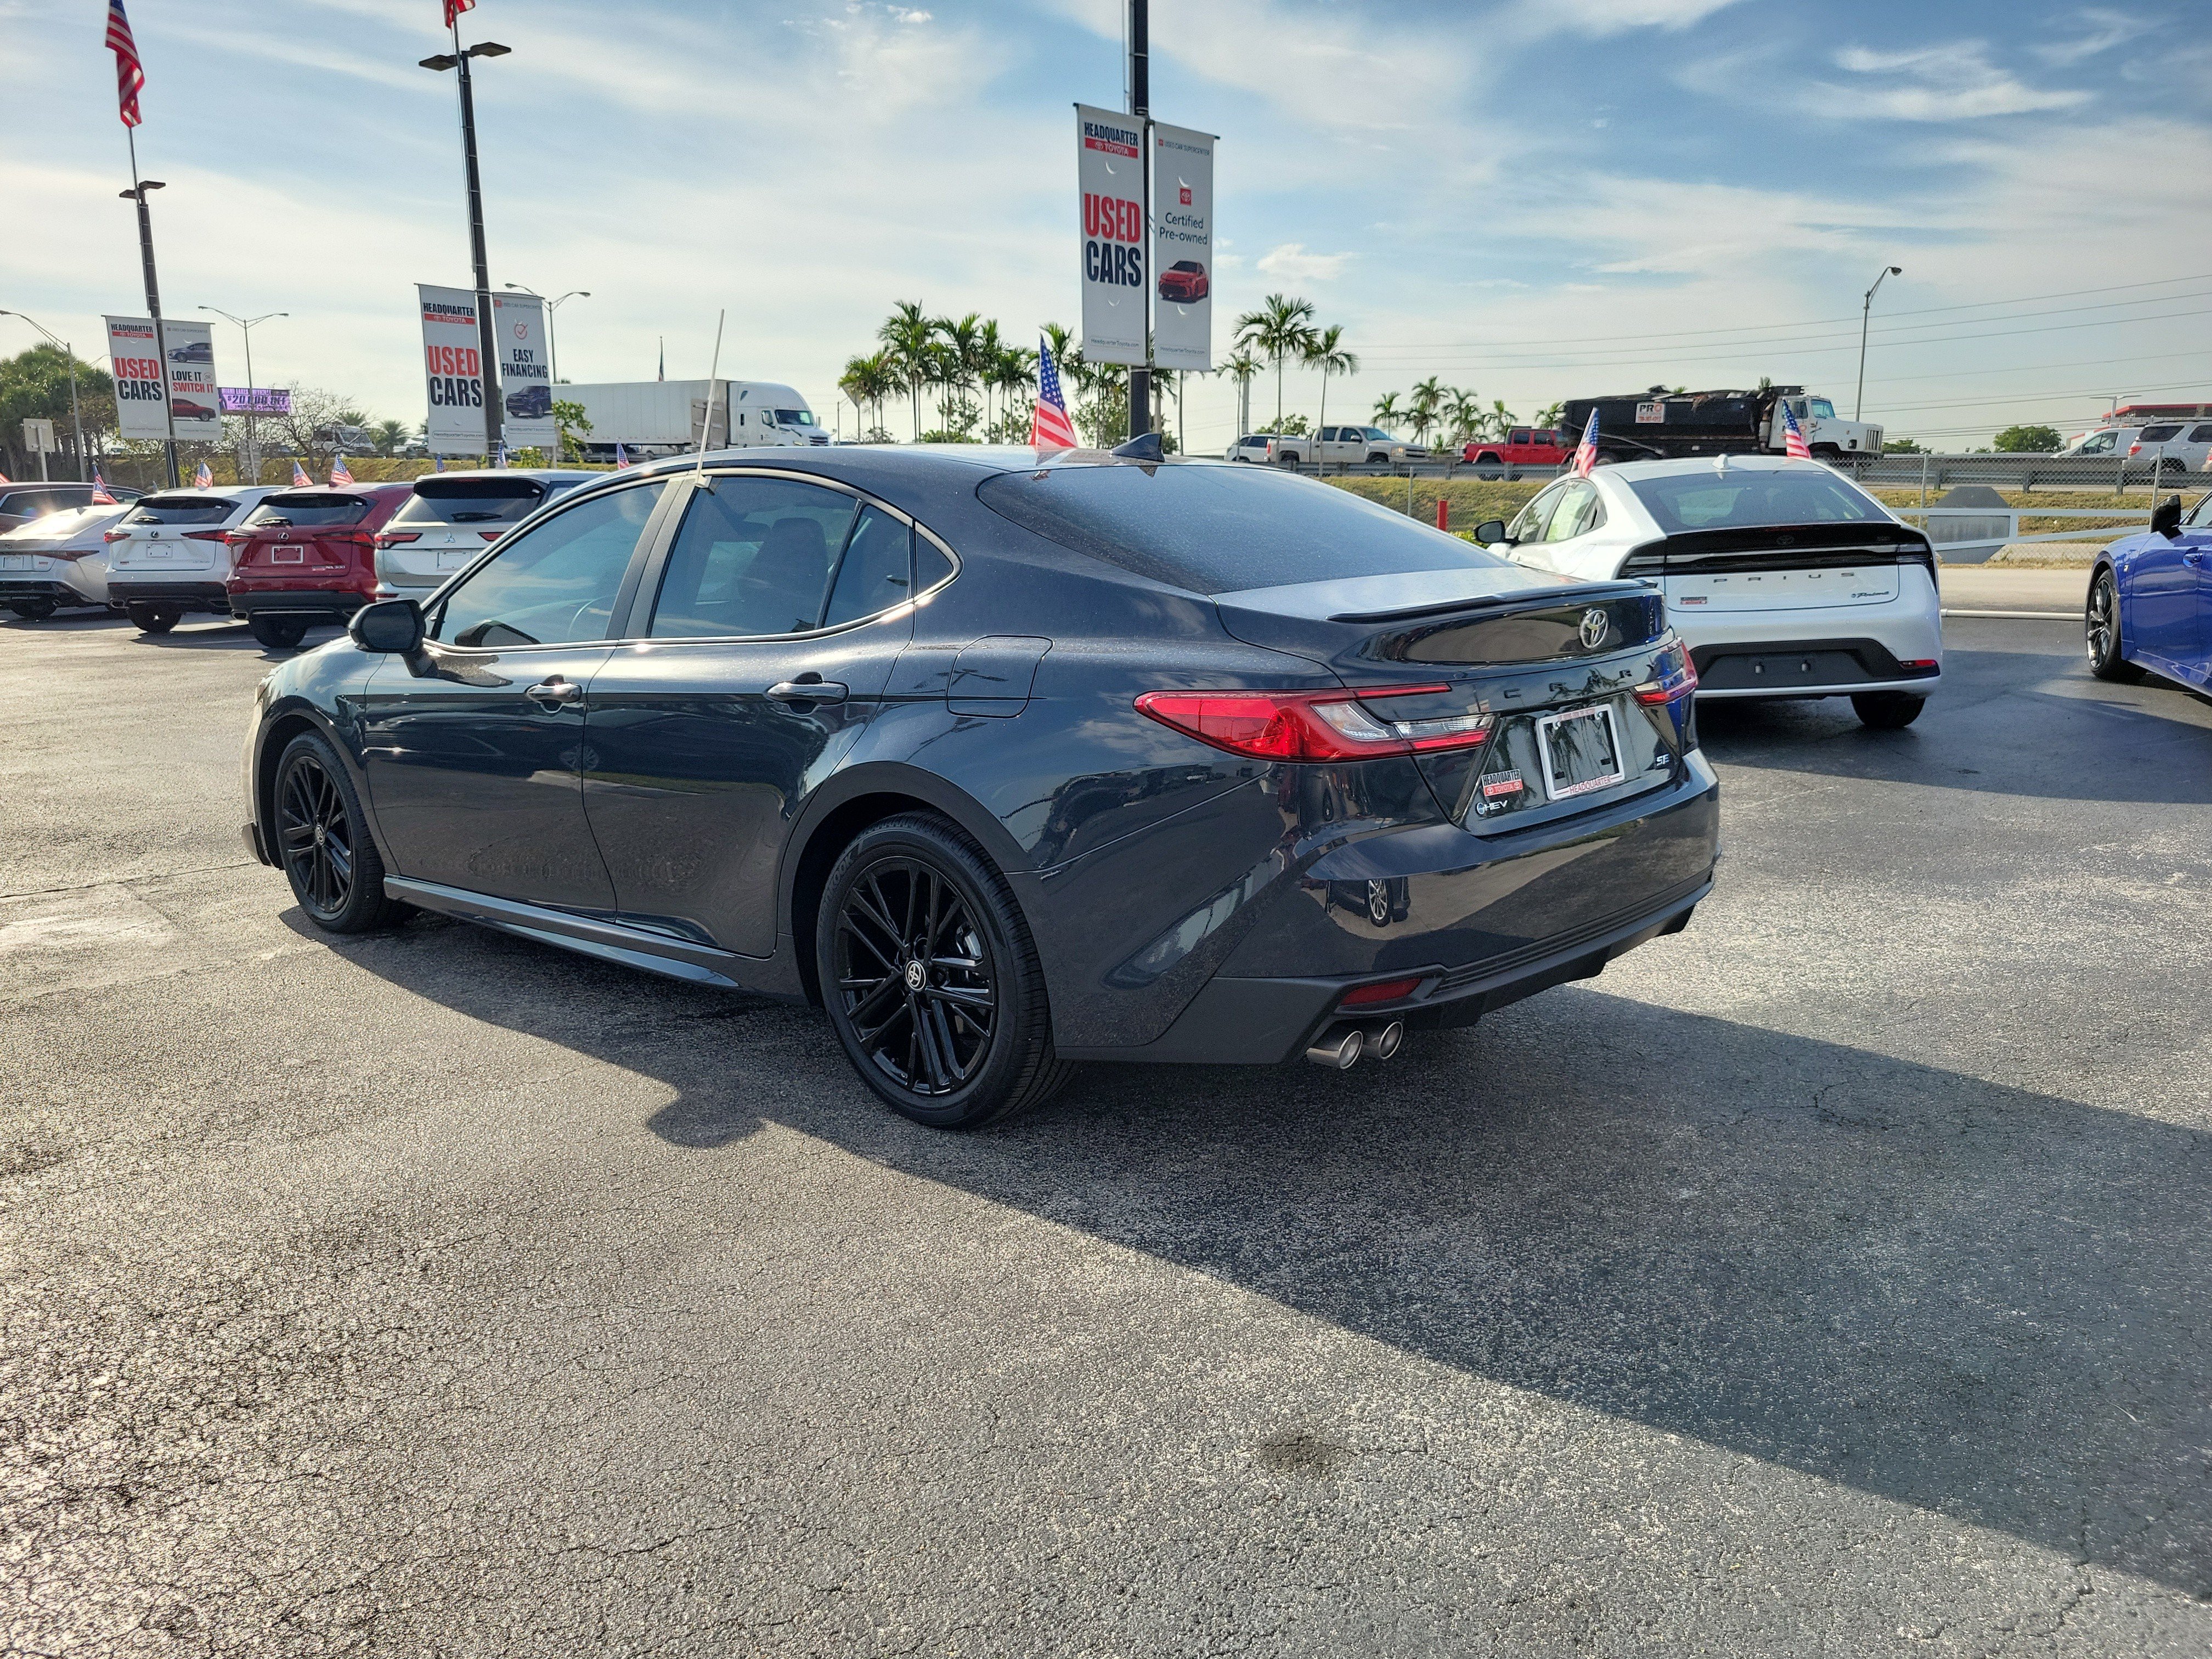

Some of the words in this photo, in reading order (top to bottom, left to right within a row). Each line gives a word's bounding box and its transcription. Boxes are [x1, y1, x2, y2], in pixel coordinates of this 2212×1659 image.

[1084, 122, 1138, 147] HEADQUARTER
[1105, 143, 1128, 156] TOYOTA
[1084, 193, 1141, 244] USED
[1165, 212, 1203, 229] Certified
[1160, 227, 1207, 245] Pre-owned
[1086, 242, 1142, 287] CARS
[424, 302, 475, 317] HEADQUARTER
[111, 324, 153, 333] HEADQUARTER
[427, 346, 479, 376] USED
[513, 349, 534, 363] EASY
[114, 357, 159, 380] USED
[171, 370, 193, 381] LOVE
[195, 371, 201, 381] IT
[502, 363, 548, 379] FINANCING
[118, 380, 163, 401] CARS
[173, 382, 205, 393] SWITCH
[207, 383, 214, 393] IT
[430, 377, 482, 407] CARS
[1639, 403, 1662, 412] PRO
[1713, 572, 1854, 583] PRIUS
[1656, 753, 1670, 766] SE
[1483, 770, 1521, 786] HEADQUARTER
[1569, 776, 1611, 794] HEADQUARTER
[1494, 784, 1514, 793] TOYOTA
[1484, 800, 1508, 811] HEV
